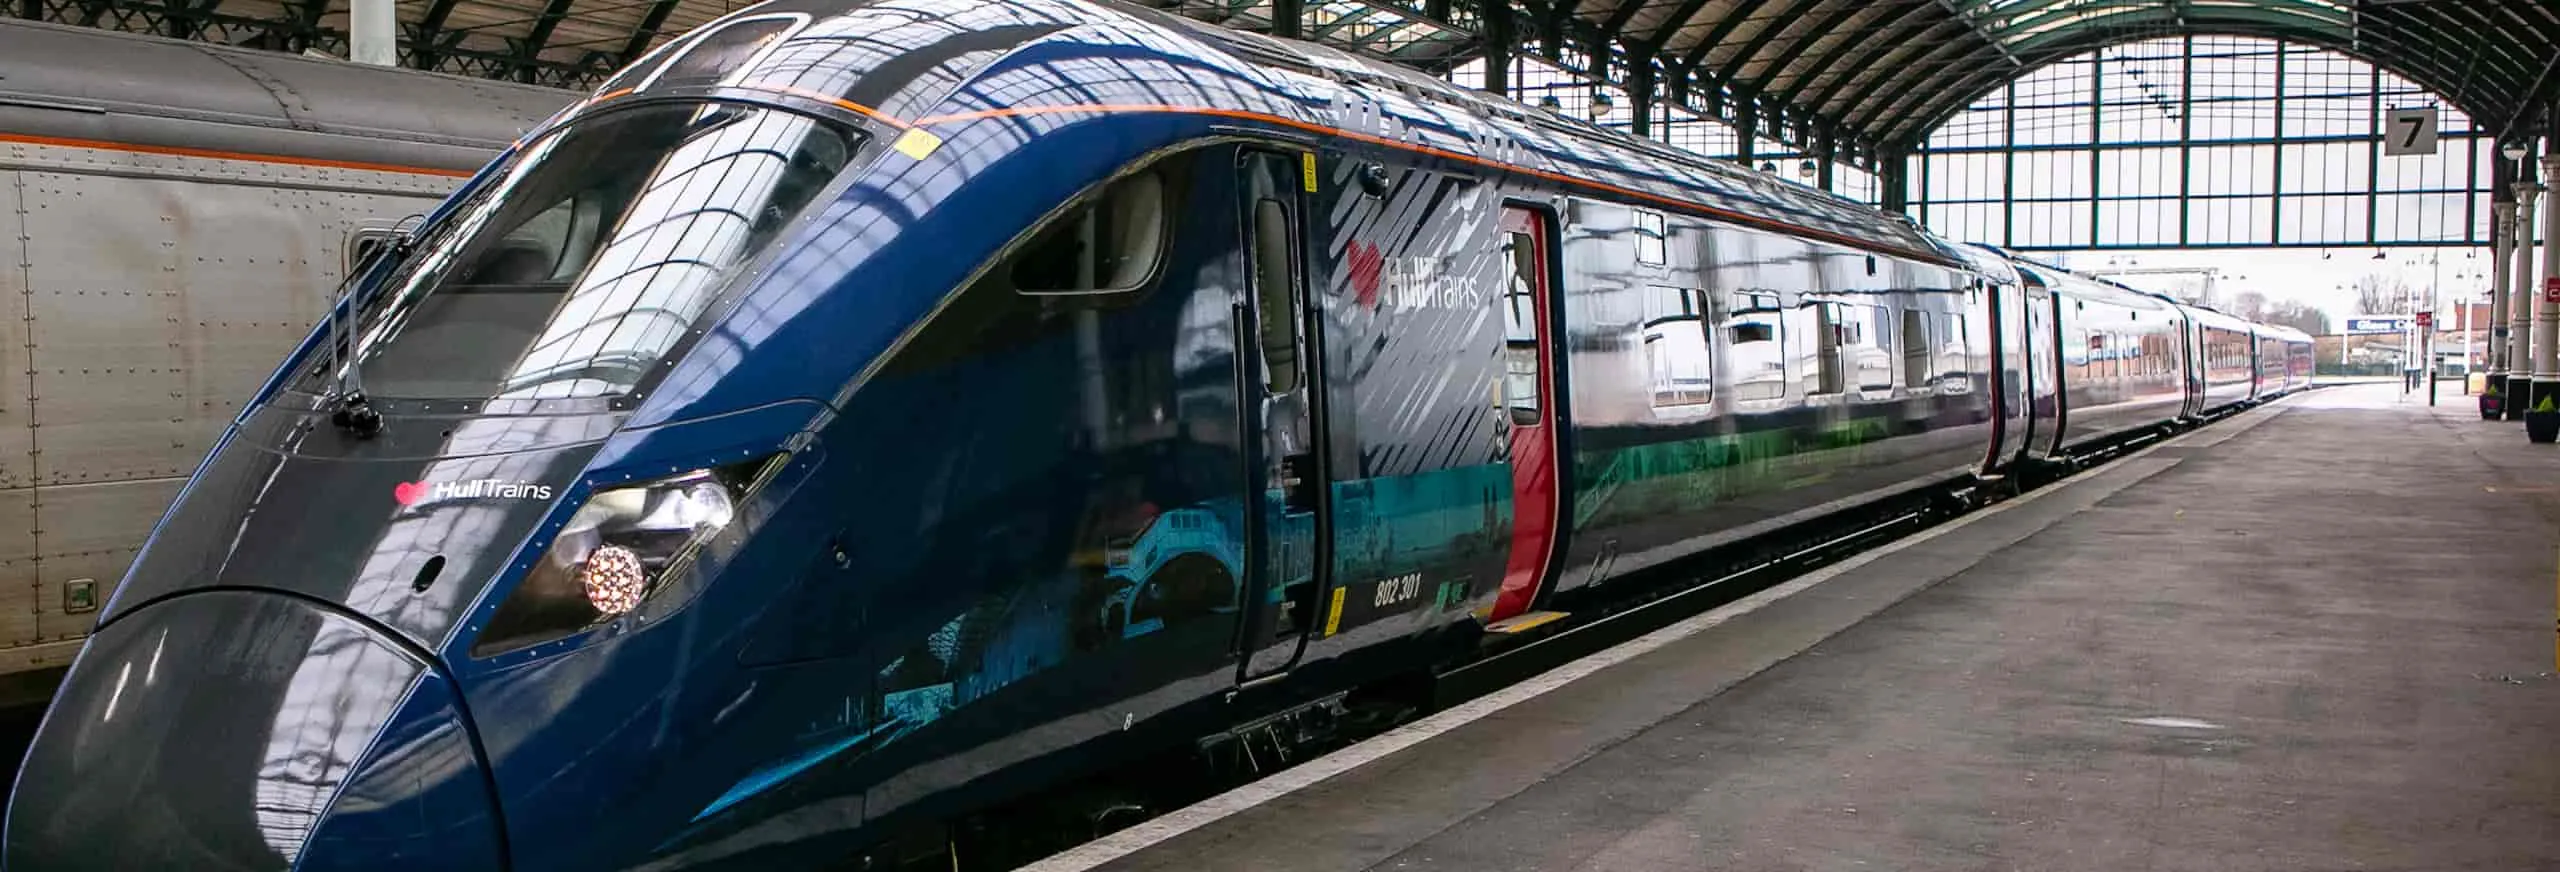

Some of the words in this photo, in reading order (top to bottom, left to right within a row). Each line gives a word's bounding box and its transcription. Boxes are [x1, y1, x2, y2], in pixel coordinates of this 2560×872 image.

[2399, 117, 2424, 148] 7
[1374, 577, 1399, 608] 802
[1398, 572, 1422, 601] 301
[1123, 711, 1133, 731] 8
